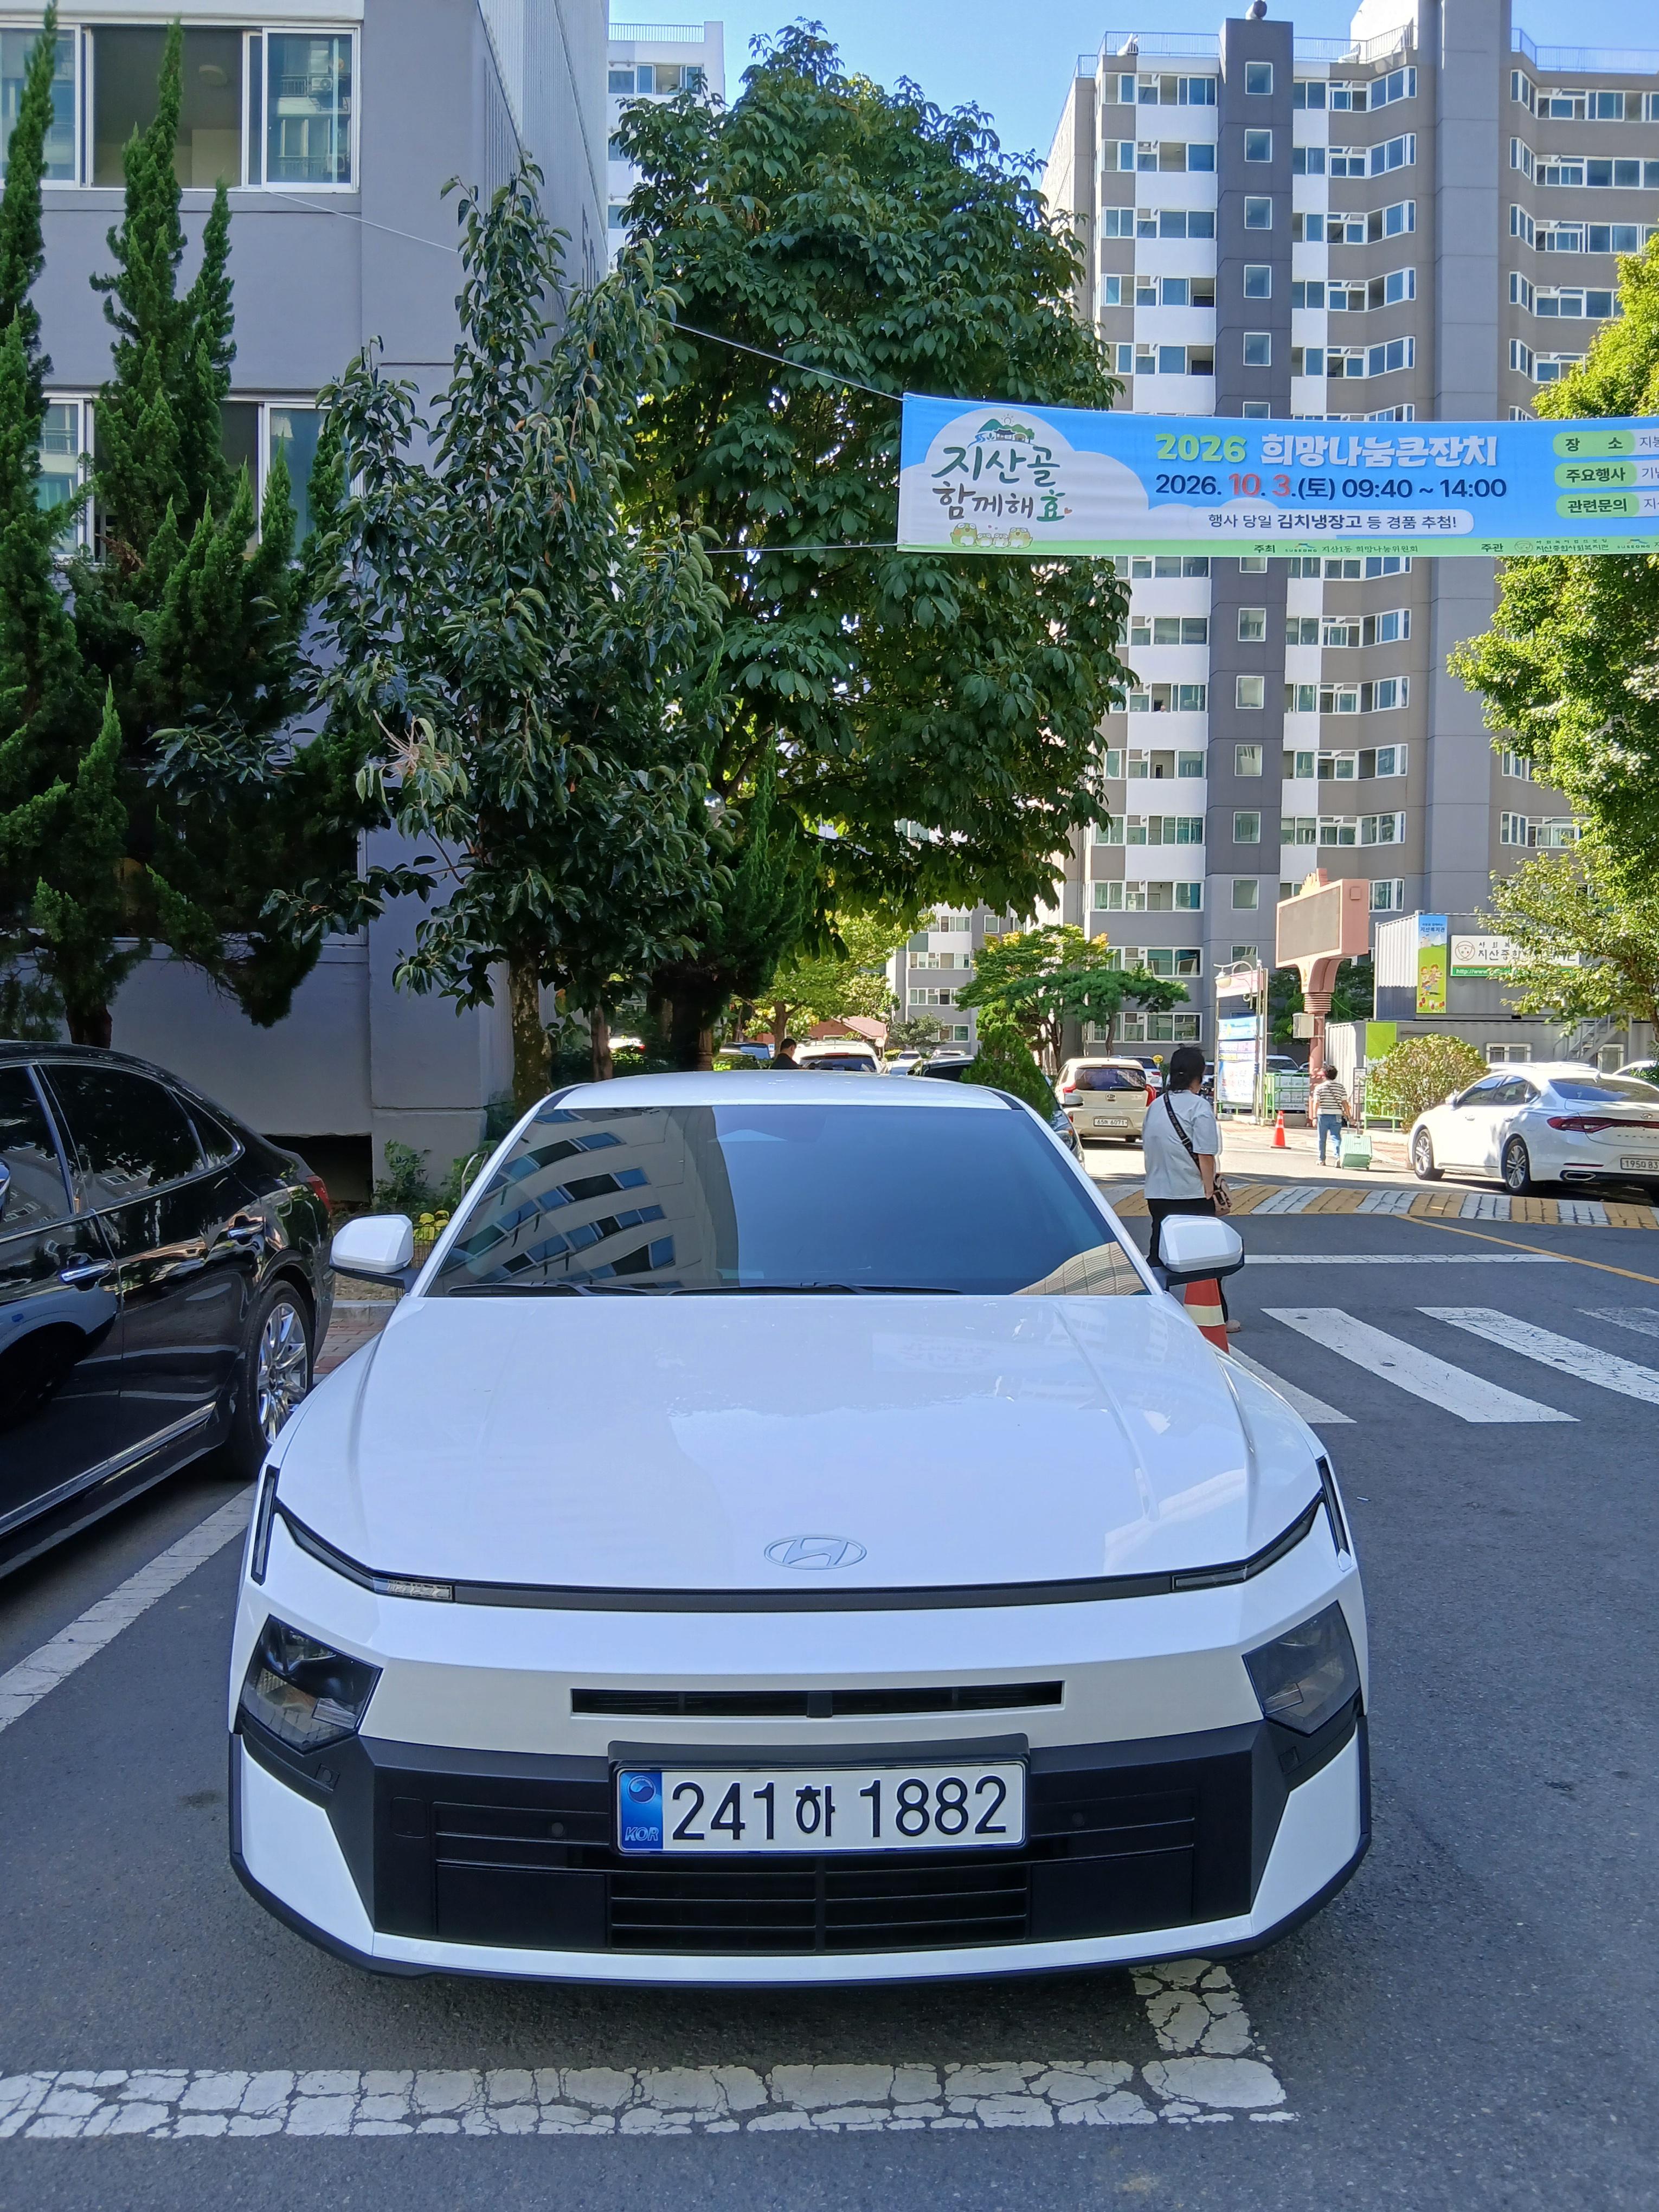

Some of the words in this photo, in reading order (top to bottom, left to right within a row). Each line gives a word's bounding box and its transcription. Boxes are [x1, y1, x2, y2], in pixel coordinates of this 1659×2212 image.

[1155, 433, 1247, 463] 2026
[1261, 433, 1498, 467] 희망나눔큰잔치
[1565, 438, 1580, 452] 장
[1607, 437, 1623, 449] 소
[931, 446, 1061, 487] 지산골
[1565, 467, 1625, 483] 주요행사
[1155, 474, 1222, 496] 2026.
[1228, 473, 1266, 497] 10.
[1342, 478, 1412, 498] 09:40
[1439, 478, 1507, 498] 14:00
[932, 481, 1066, 522] 함께해효
[1567, 498, 1627, 513] 관련문의
[1644, 498, 1659, 510] 지
[1208, 514, 1238, 528] 행사
[1243, 515, 1272, 529] 당일
[1277, 514, 1362, 530] 김치냉장고
[1366, 516, 1382, 530] 등
[1386, 516, 1417, 530] 경품
[1421, 516, 1457, 530] 추첨!
[1253, 544, 1275, 554] 주최
[1481, 543, 1504, 552] 주관
[1648, 1161, 1659, 1169] 83
[671, 1781, 836, 1840] 241하
[859, 1774, 1007, 1838] 1882
[624, 1826, 660, 1842] KOR
